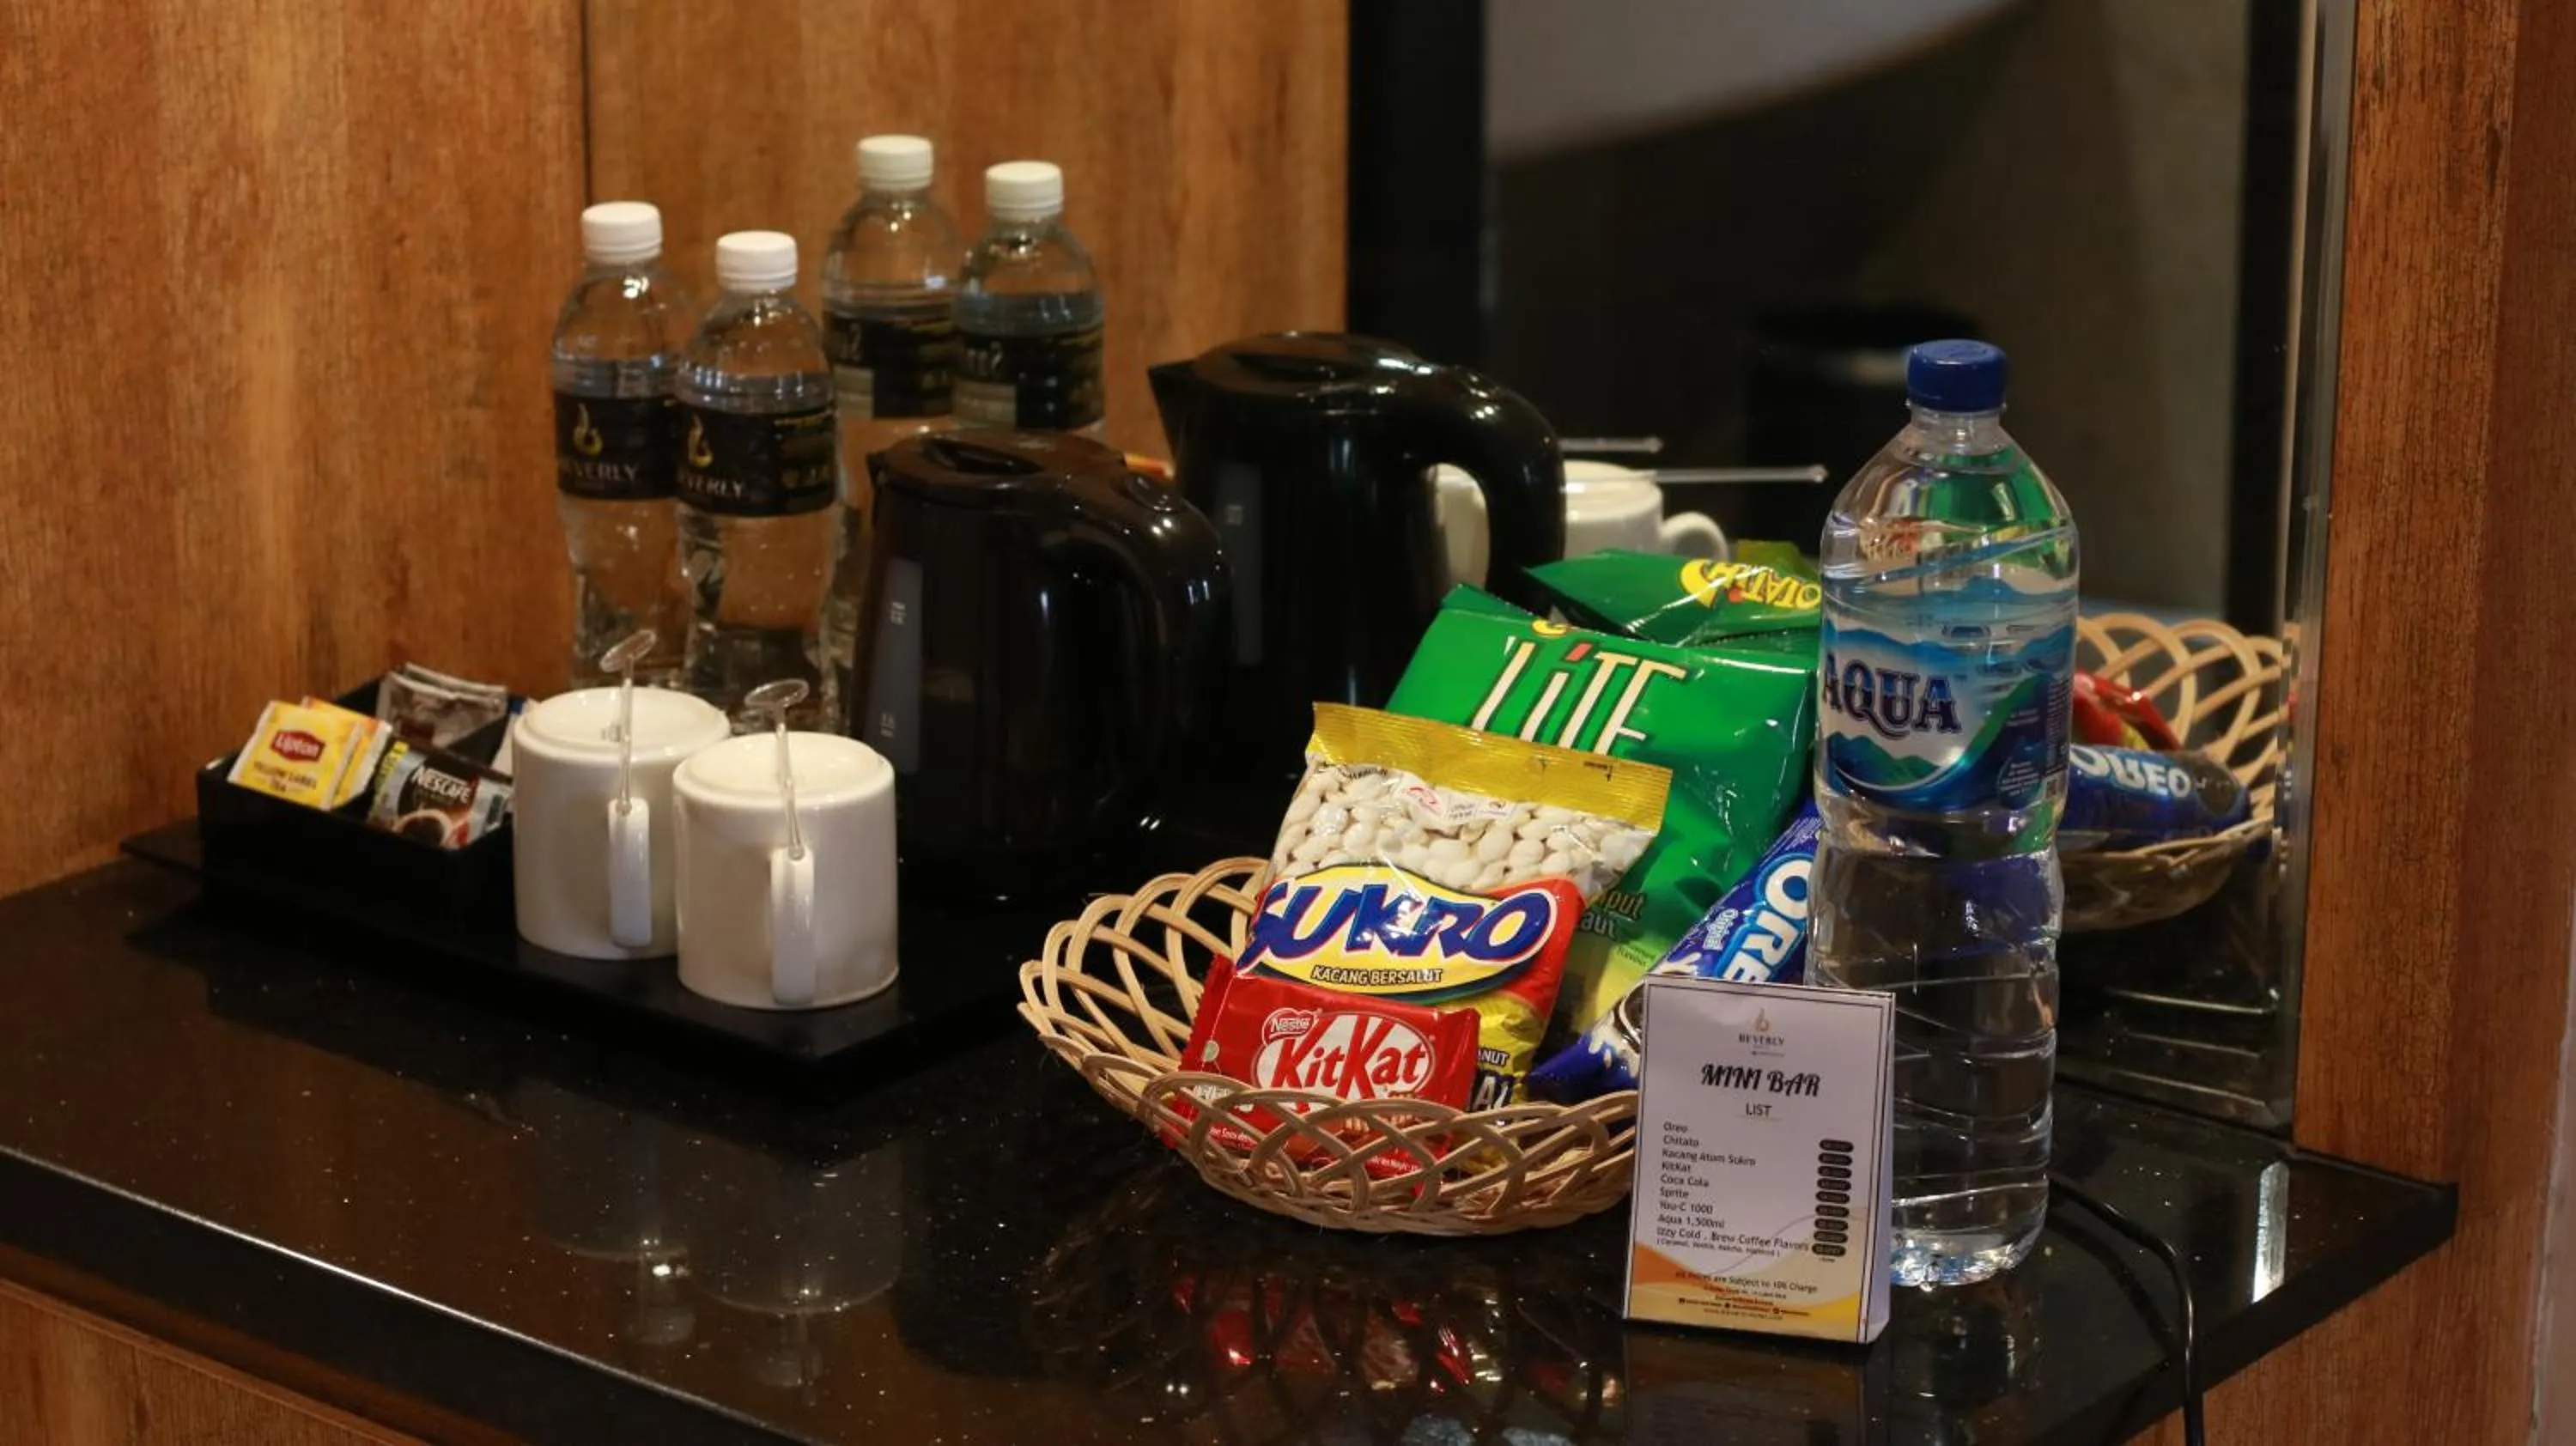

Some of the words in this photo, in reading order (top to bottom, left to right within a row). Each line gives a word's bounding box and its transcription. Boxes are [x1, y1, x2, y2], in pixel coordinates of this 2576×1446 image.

[1823, 651, 1962, 739] AQUA
[1603, 890, 1645, 919] put
[1236, 879, 1552, 971] SUKRO
[1581, 911, 1615, 939] aut
[1723, 860, 1813, 982] ORE
[1311, 964, 1369, 985] KACANG
[1370, 967, 1443, 987] BERSALUT
[1739, 1033, 1785, 1046] BEVERLY
[1273, 1015, 1426, 1098] KitKat
[1477, 1048, 1509, 1066] NUT
[1701, 1063, 1763, 1091] MINI
[1766, 1071, 1820, 1097] BAR
[1746, 1102, 1773, 1117] LIST
[1663, 1121, 1688, 1133] Oreo
[1663, 1134, 1699, 1147] Chitato
[1662, 1148, 1698, 1163] Kacang
[1660, 1174, 1684, 1185] Coca
[1687, 1176, 1710, 1187] Cola
[1660, 1187, 1689, 1199] Sprite
[1690, 1204, 1713, 1215] 1000
[1657, 1214, 1682, 1226] Aqua
[1679, 1229, 1701, 1239] Cold
[1711, 1231, 1735, 1242] Brew
